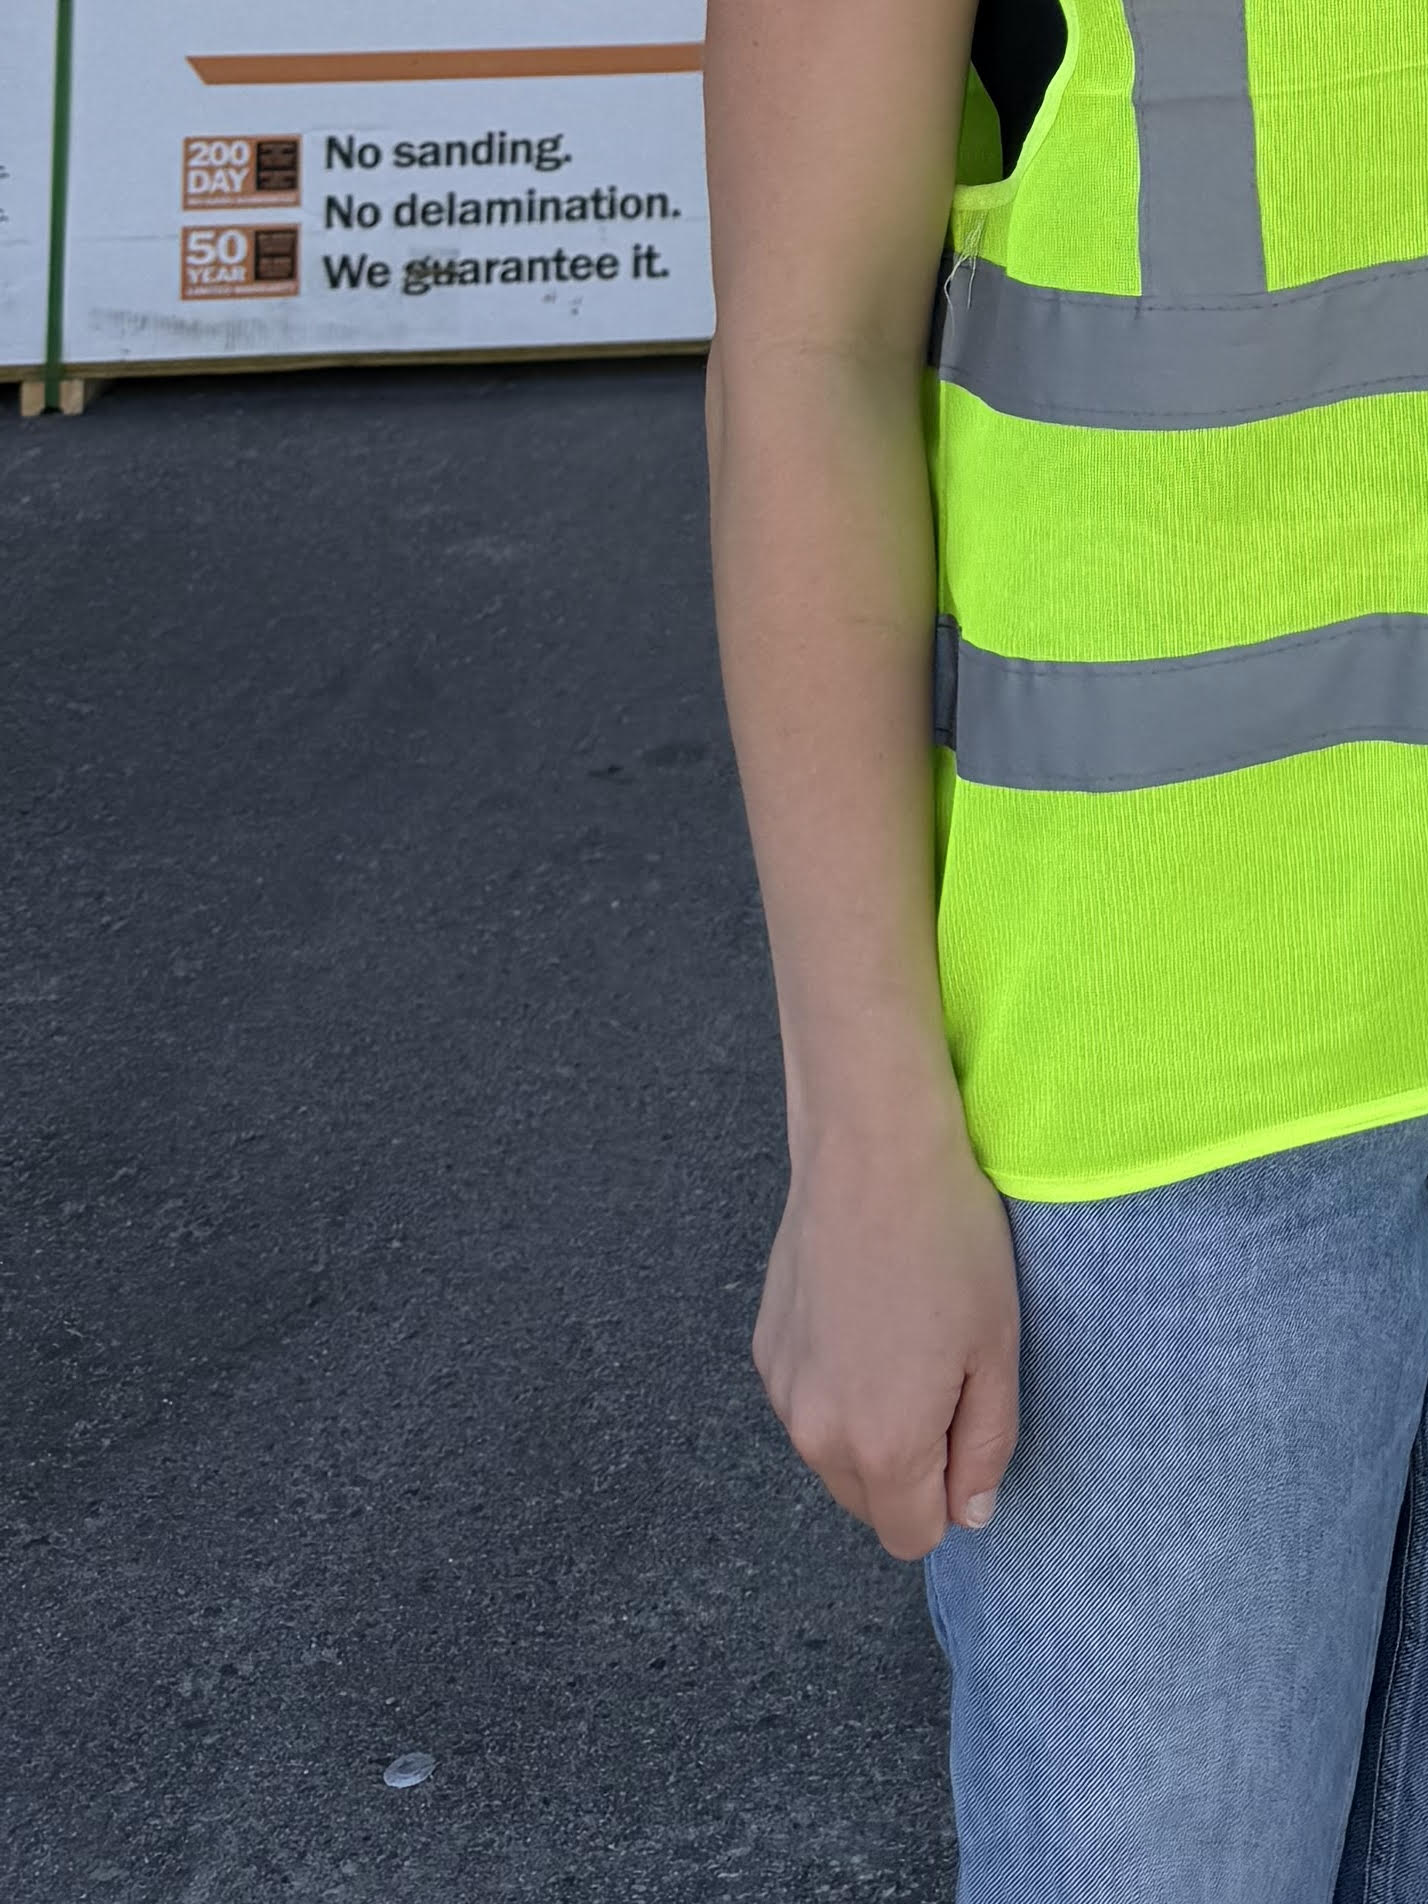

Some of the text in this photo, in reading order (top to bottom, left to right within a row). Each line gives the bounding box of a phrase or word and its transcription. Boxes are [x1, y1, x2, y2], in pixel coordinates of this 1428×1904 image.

[188, 139, 251, 169] 200
[326, 132, 572, 172] No sanding.
[187, 168, 249, 195] DAY
[325, 186, 680, 229] No delamination.
[186, 230, 248, 266] 50
[186, 265, 245, 285] YEAR
[322, 245, 667, 296] We guarantee it.
